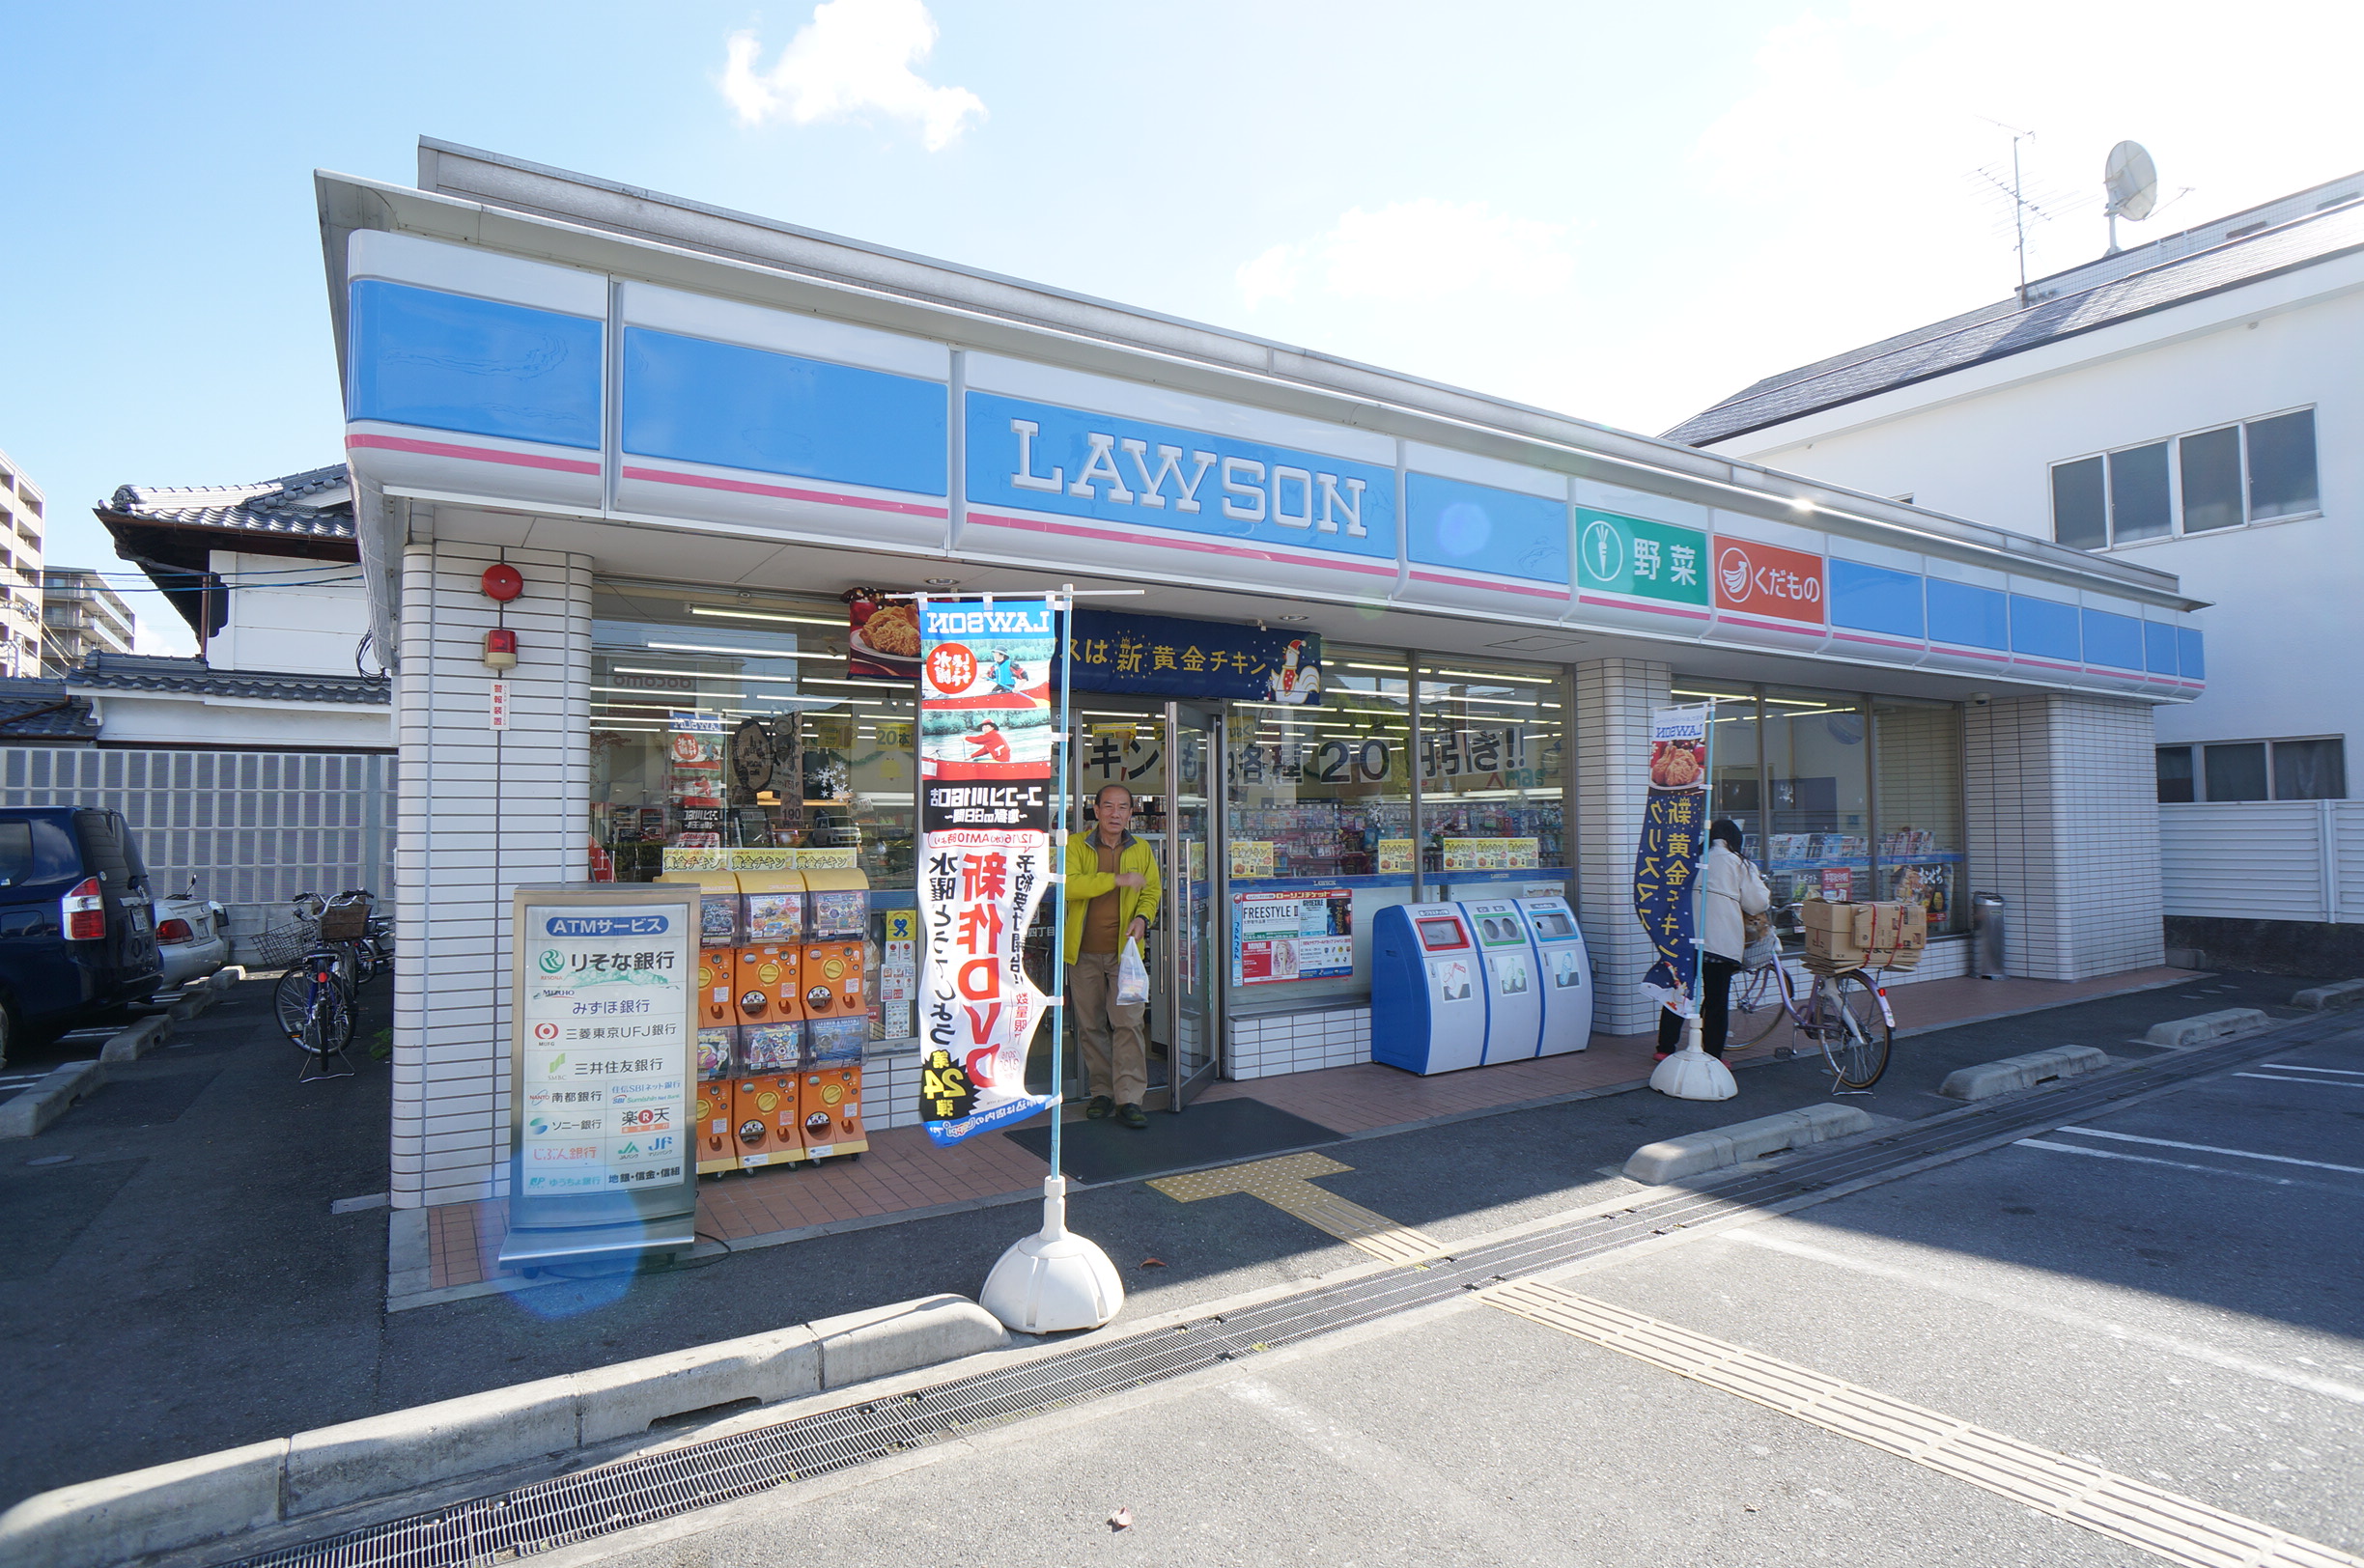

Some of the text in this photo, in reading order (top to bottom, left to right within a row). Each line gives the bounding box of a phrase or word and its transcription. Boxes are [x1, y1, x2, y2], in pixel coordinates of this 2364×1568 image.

[1010, 418, 1367, 539] LAWSON
[1634, 537, 1697, 585] 野菜
[1754, 566, 1820, 603] くだもの
[1059, 629, 1267, 676] スは新黄金チキン
[1243, 906, 1291, 919] FREESTYLE
[552, 917, 663, 935] ATMサービス
[571, 950, 676, 973] りそな銀行
[573, 998, 651, 1015] みずほ銀行
[566, 1022, 677, 1041] 三菱東京UFJ銀行
[575, 1057, 663, 1076] 三井住友銀行
[611, 1081, 681, 1094] 住信SBIネット銀行
[551, 1090, 603, 1104] 南都銀行
[552, 1118, 603, 1132] ソニー銀行
[533, 1146, 597, 1161] じぶん銀行
[549, 1176, 601, 1187] ゆうちょ銀行
[608, 1166, 681, 1184] 地銀・信金・信組
